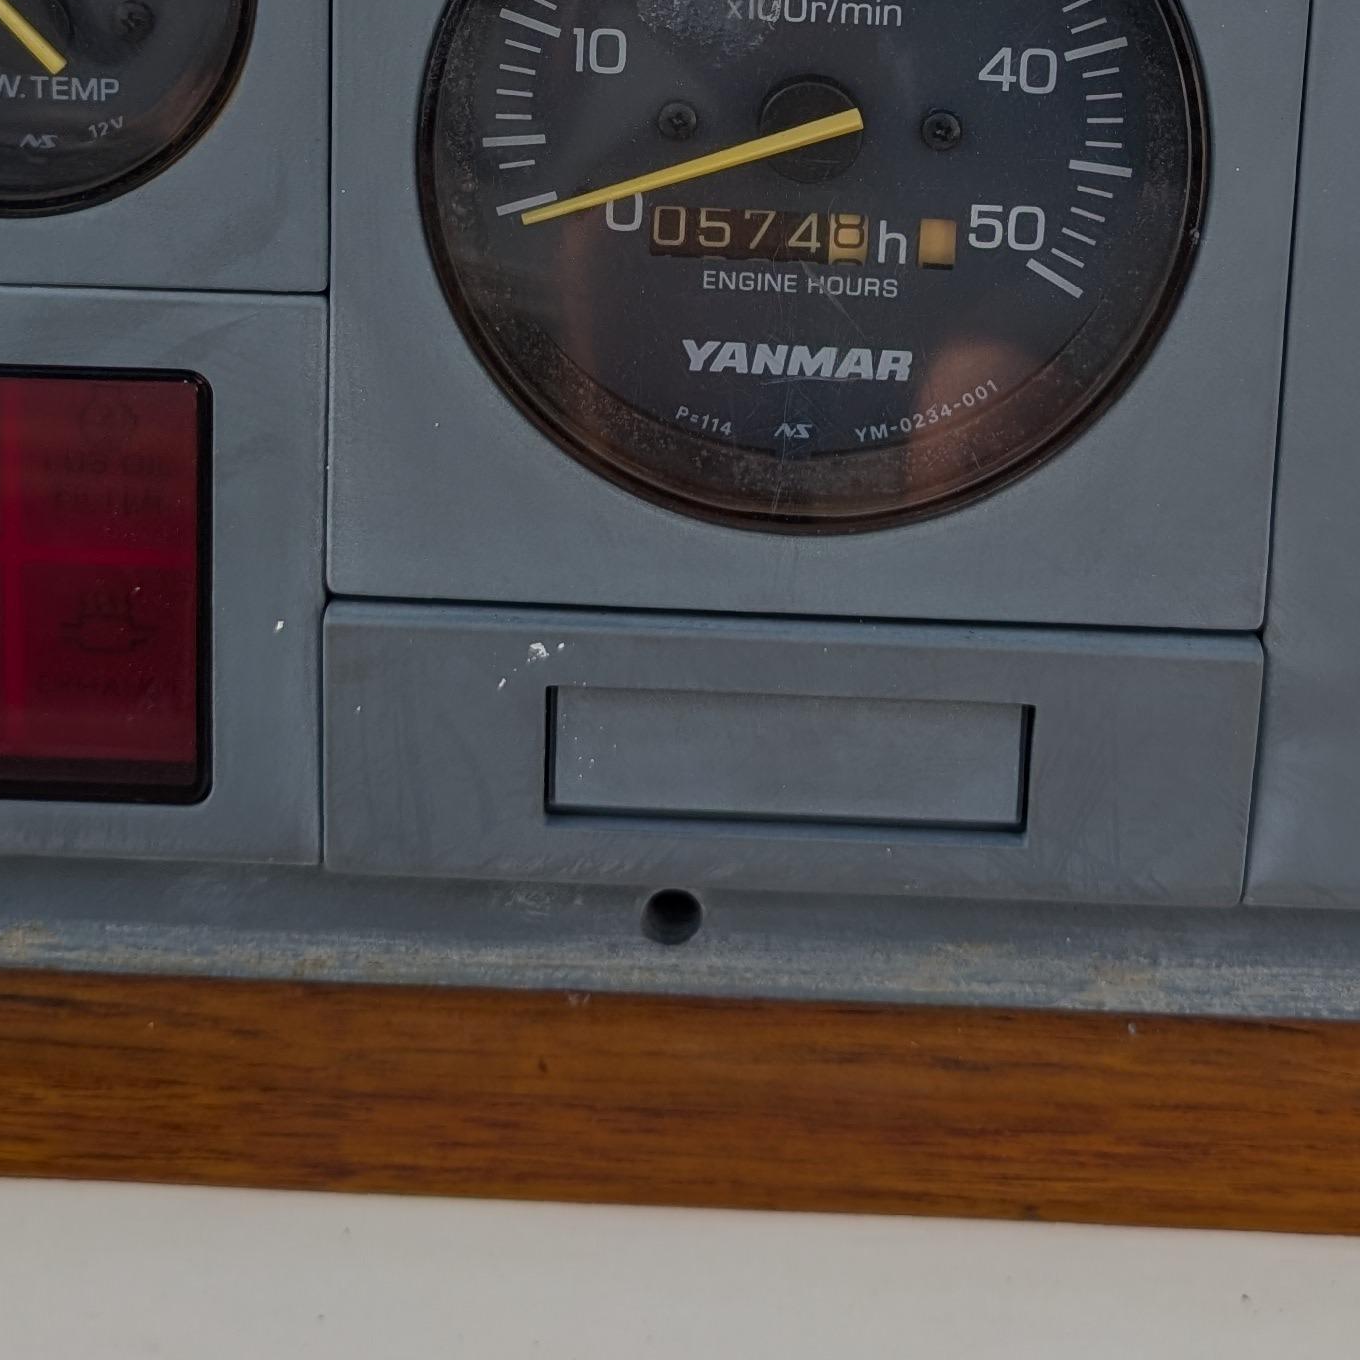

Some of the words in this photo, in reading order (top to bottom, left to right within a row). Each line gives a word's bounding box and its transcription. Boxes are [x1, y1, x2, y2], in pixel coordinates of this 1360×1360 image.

[572, 28, 627, 74] 10
[978, 49, 1057, 94] 40
[605, 190, 643, 232] 0
[968, 206, 1046, 251] 50
[703, 270, 797, 293] ENGINE
[807, 276, 898, 298] HOURS
[680, 339, 912, 382] YANMAR
